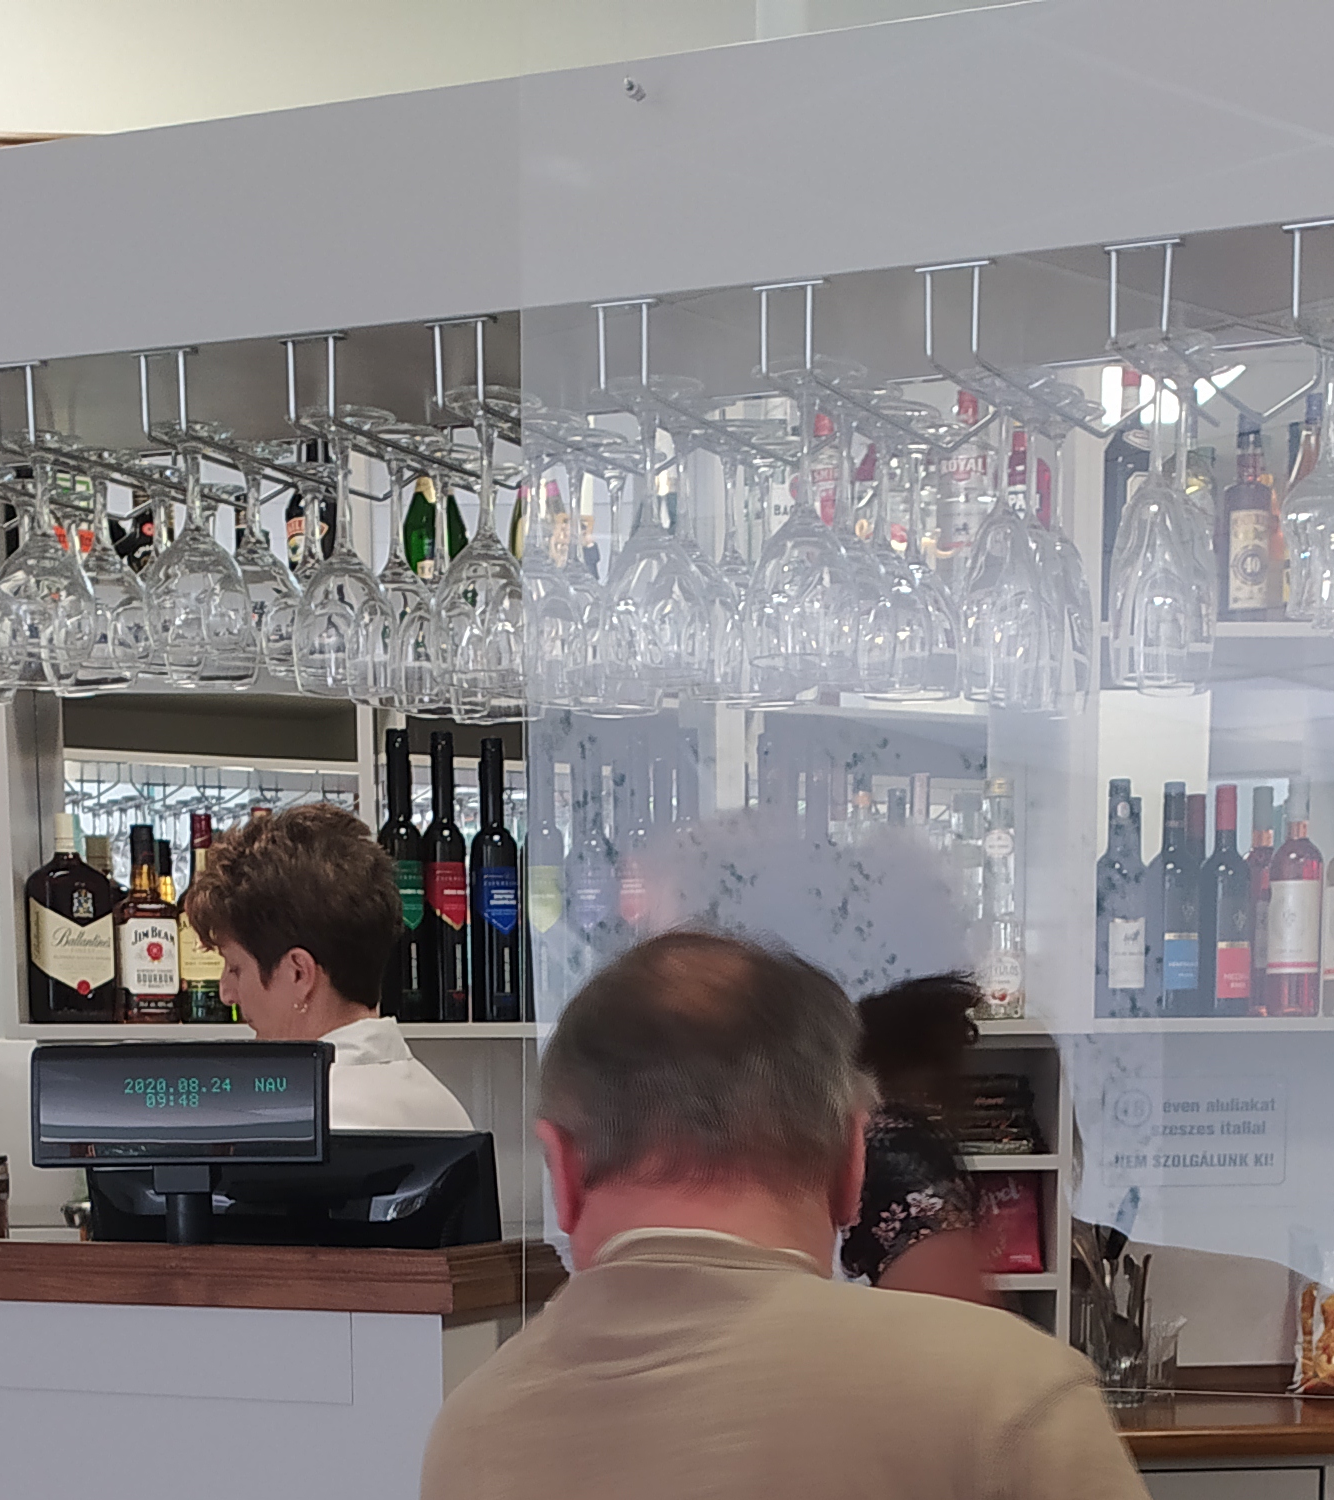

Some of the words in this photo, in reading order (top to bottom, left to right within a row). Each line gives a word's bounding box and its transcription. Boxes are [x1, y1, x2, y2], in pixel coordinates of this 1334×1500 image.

[132, 929, 150, 946] JIM
[151, 926, 175, 946] BEAM
[124, 1077, 232, 1094] 2020.08.24
[254, 1077, 287, 1093] NAV
[146, 1093, 199, 1108] 09:48
[1152, 1150, 1248, 1169] SZOLGÁLUNK
